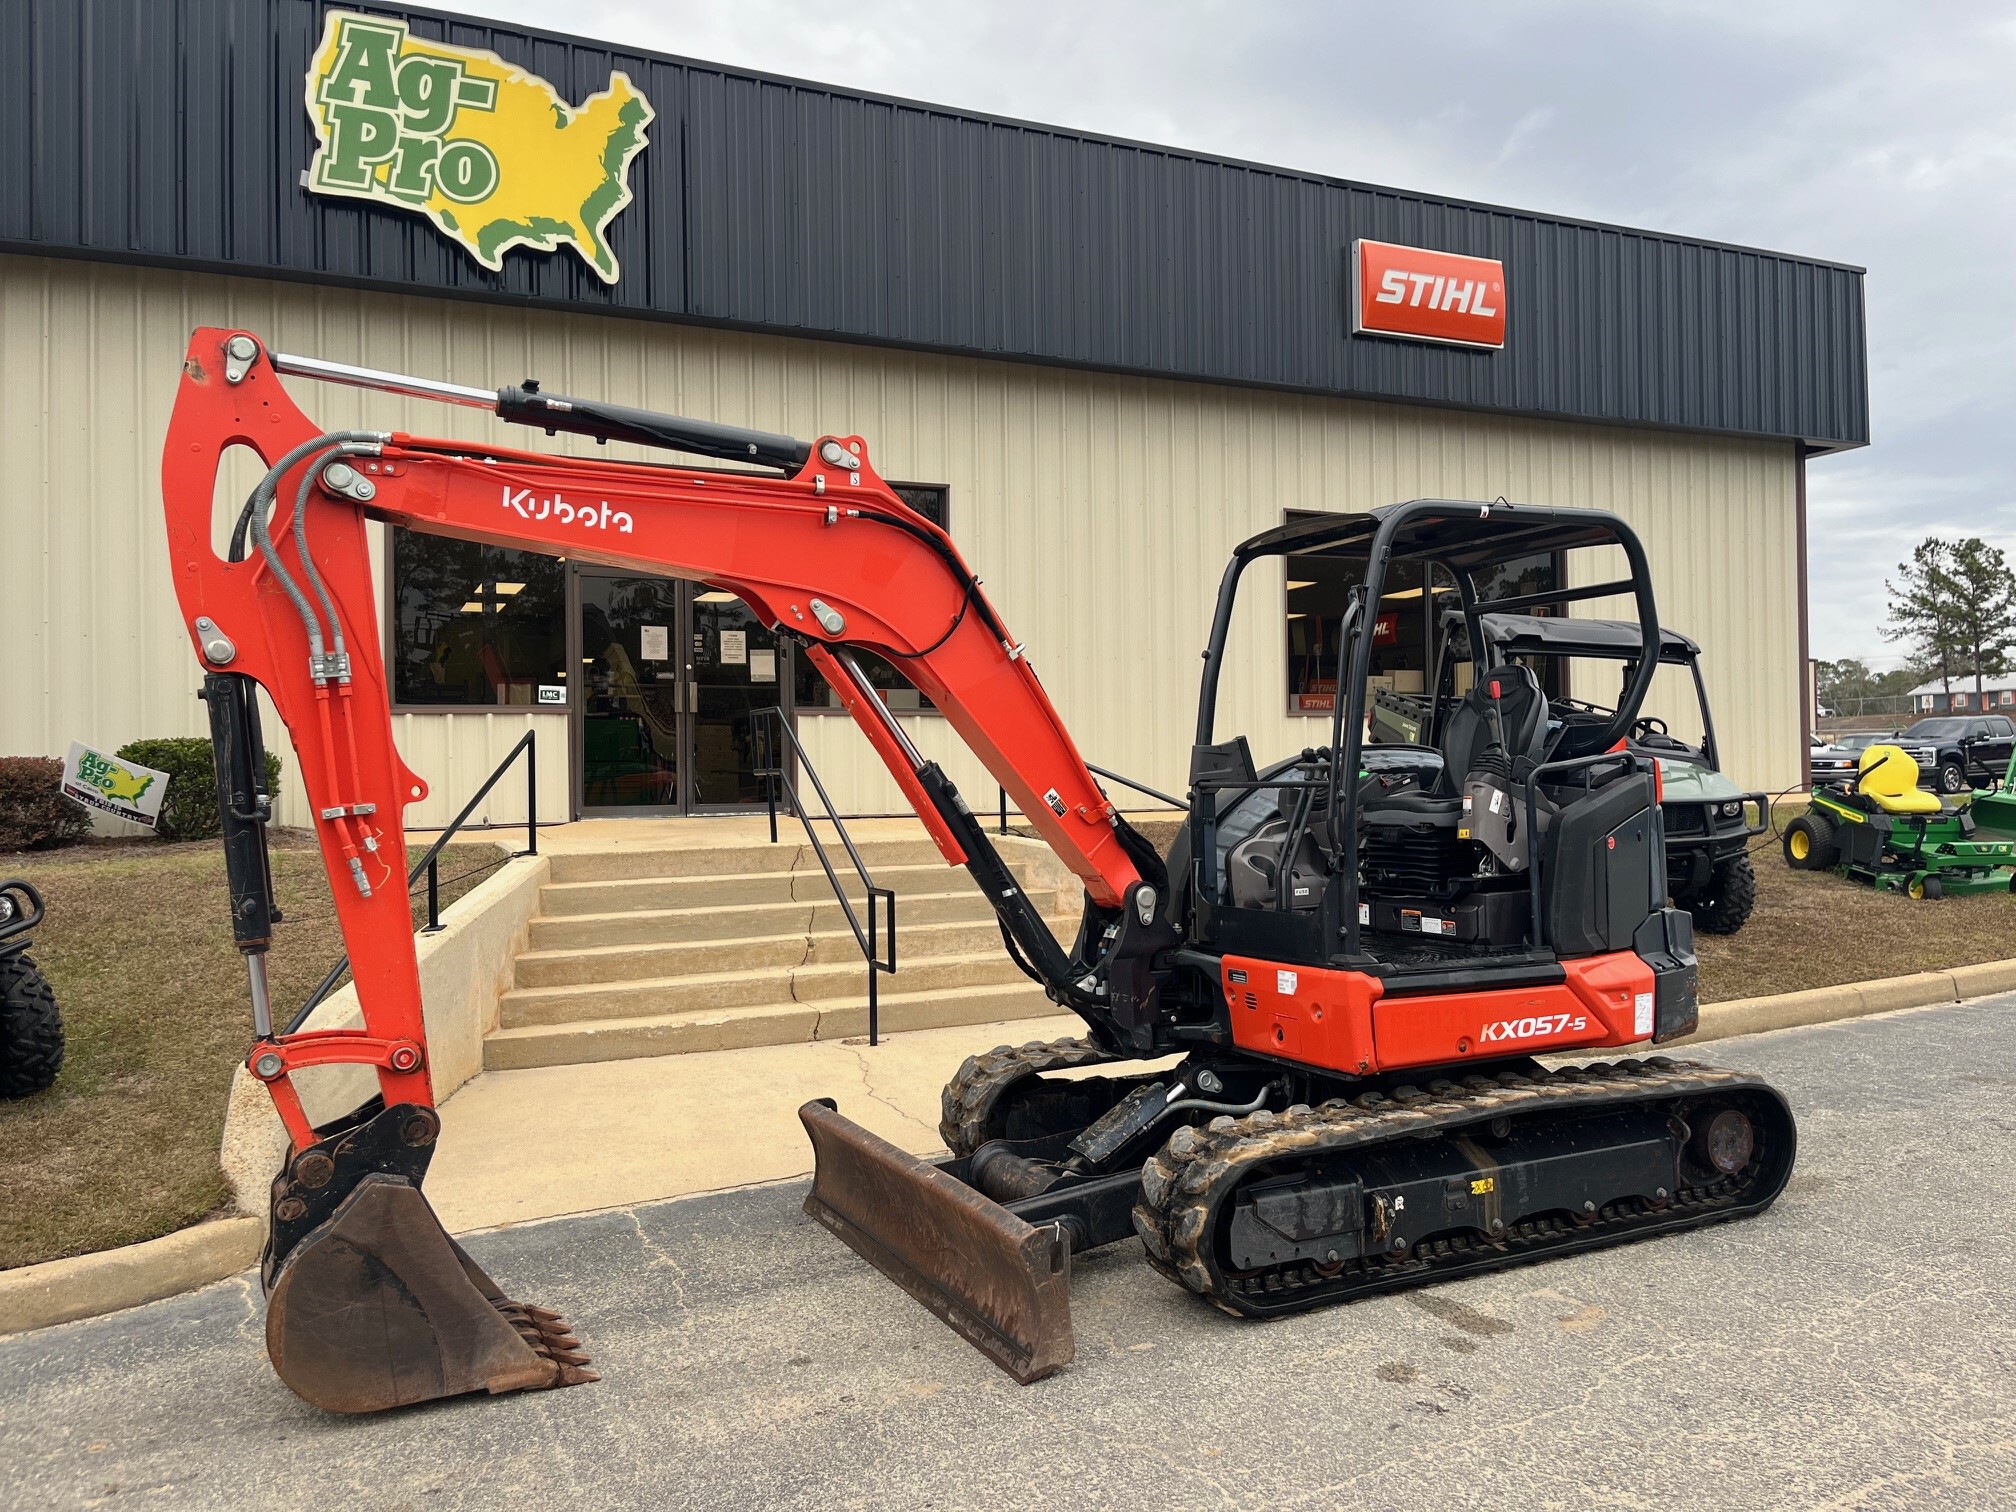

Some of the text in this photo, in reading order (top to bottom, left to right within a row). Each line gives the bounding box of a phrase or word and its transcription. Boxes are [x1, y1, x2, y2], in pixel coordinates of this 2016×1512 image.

[319, 20, 497, 136] Ag-
[319, 104, 498, 202] Pro
[1376, 269, 1496, 317] STIHL
[502, 486, 633, 533] Kubota
[1303, 700, 1332, 708] STIHL
[77, 765, 116, 789] Pro
[80, 750, 119, 774] Ag-
[1480, 1013, 1587, 1042] KX057-5
